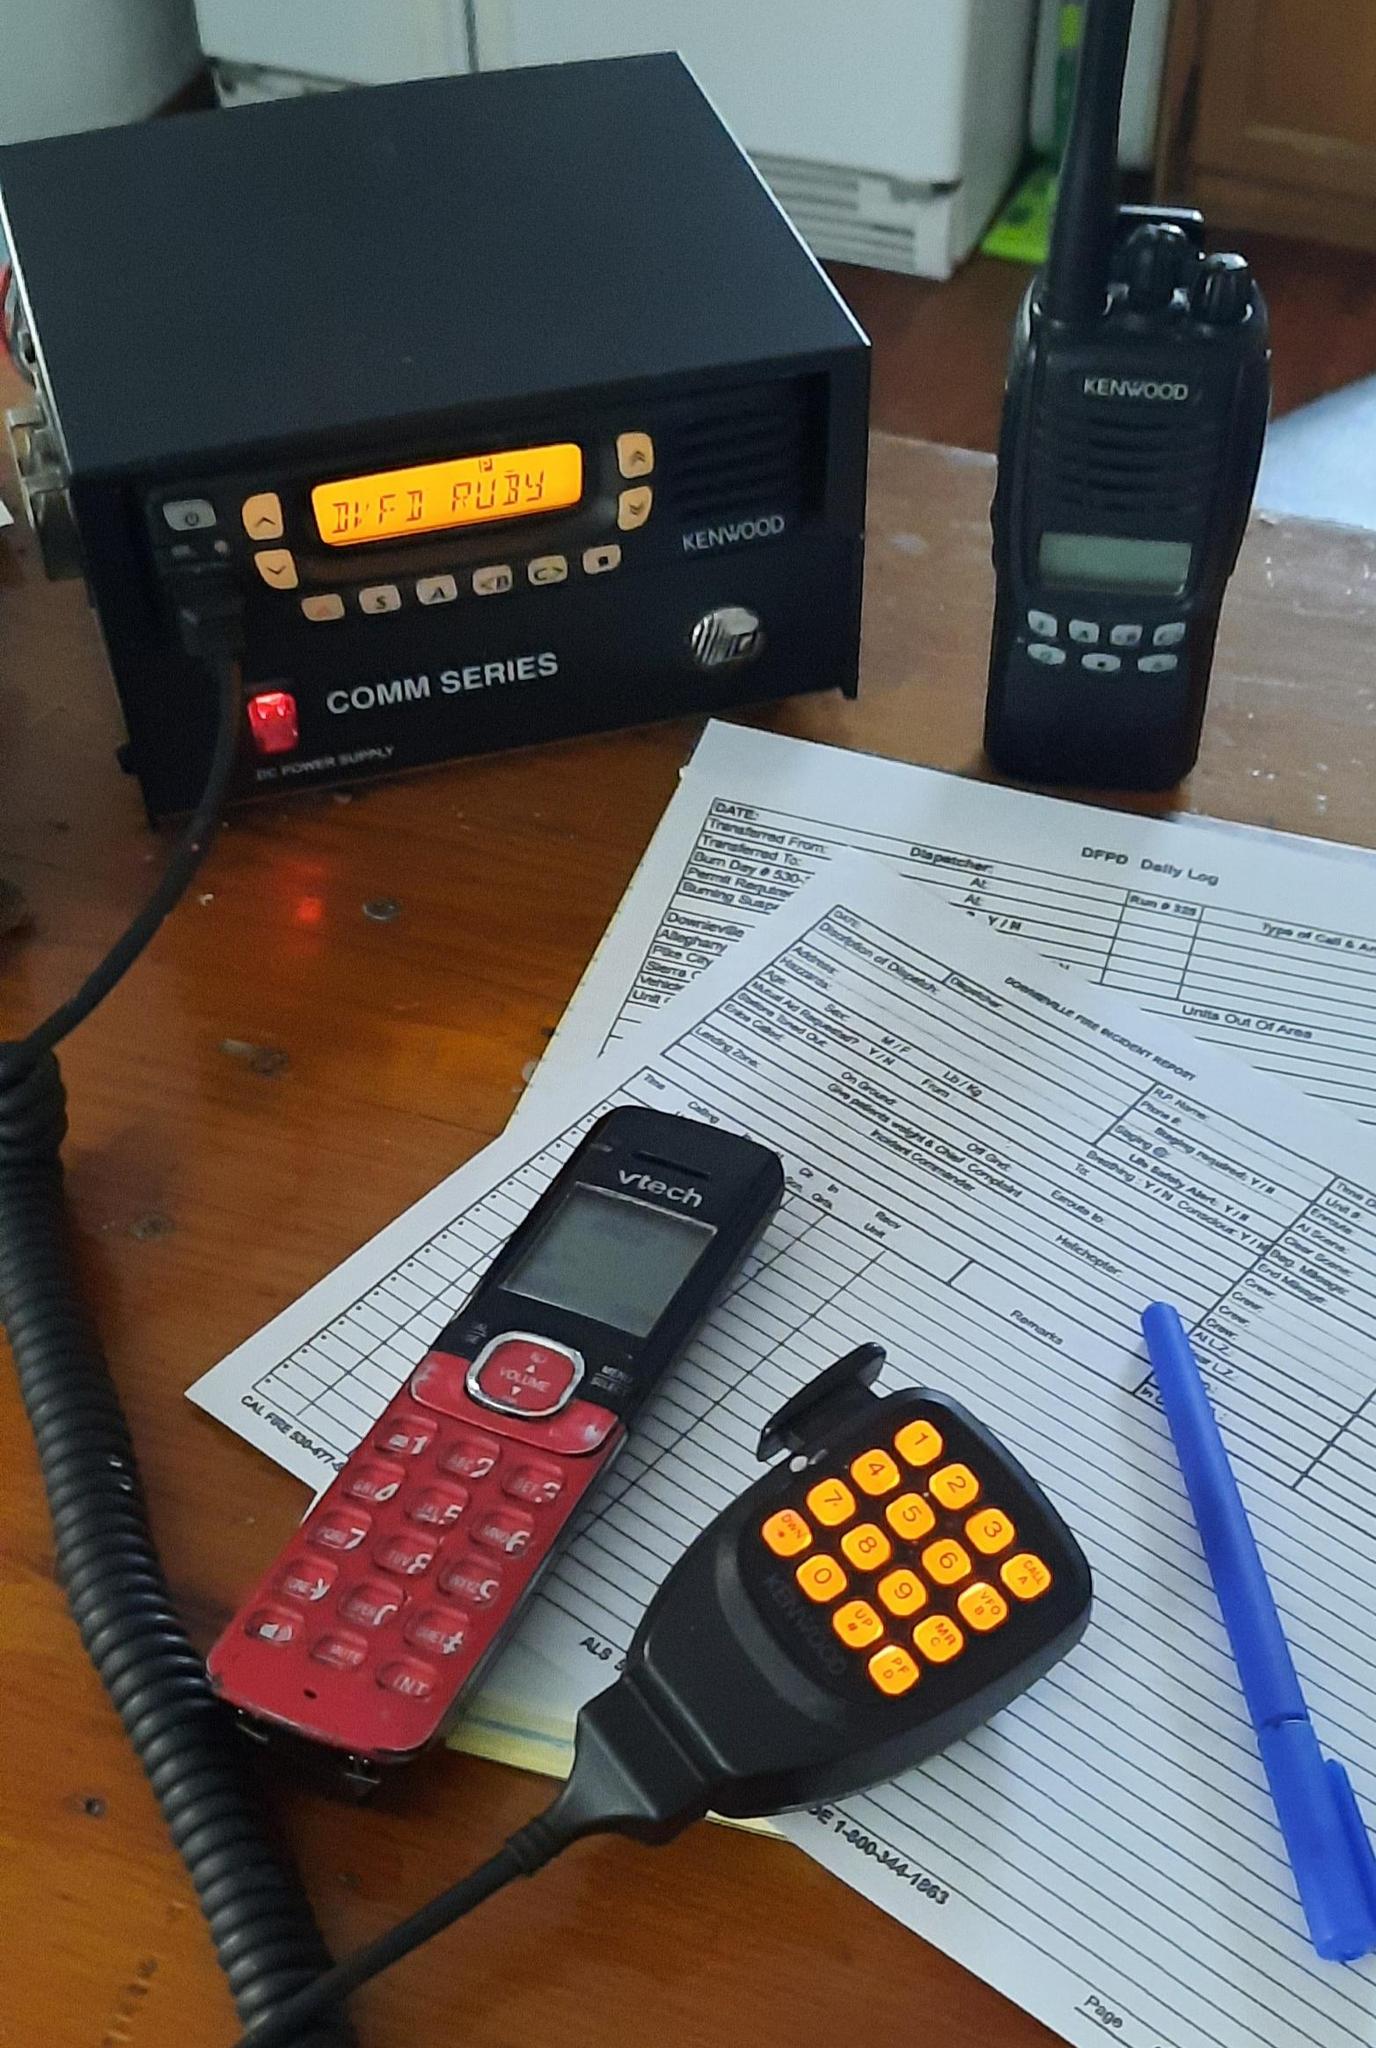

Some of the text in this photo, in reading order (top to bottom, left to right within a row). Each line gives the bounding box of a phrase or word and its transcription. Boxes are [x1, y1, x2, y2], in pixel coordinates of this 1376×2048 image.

[1083, 377, 1189, 401] KENWOOD
[682, 515, 785, 552] KENWOOD
[326, 652, 559, 714] COMM SERIES
[281, 756, 337, 775] POWER
[339, 746, 395, 766] SUPPLY
[709, 817, 785, 845] Transferred
[702, 835, 778, 861] Transferred
[687, 866, 731, 884] Permit
[729, 859, 757, 876] Day
[1081, 846, 1219, 887] DFPD Daily Log
[1262, 921, 1293, 938] Type
[1297, 929, 1312, 940] of
[1182, 1004, 1313, 1039] Units Out Of Area
[1100, 1027, 1152, 1058] INCIDENT
[1152, 1055, 1196, 1081] REPORT
[617, 1168, 703, 1209] vtech
[1009, 1309, 1064, 1346] Remarks
[500, 1366, 550, 1393] VOLUME
[241, 1395, 266, 1417] CAL
[264, 1412, 293, 1435] FIRE
[410, 1435, 428, 1455] 1
[915, 1432, 929, 1447] 1
[867, 1461, 886, 1478] 4
[946, 1475, 967, 1493] 2
[823, 1488, 843, 1506] 7
[901, 1504, 922, 1523] 5
[344, 1527, 367, 1550] 7
[780, 1512, 806, 1541] DWN
[983, 1521, 1003, 1539] 3
[857, 1535, 878, 1555] 8
[938, 1551, 959, 1570] 6
[1022, 1559, 1045, 1586] CALL
[813, 1567, 833, 1585] 0
[893, 1581, 914, 1600] 9
[979, 1590, 1001, 1617] VFO
[854, 1608, 875, 1628] UP
[934, 1621, 958, 1646] MR
[579, 1636, 613, 1661] ALS
[891, 1656, 910, 1675] PF
[393, 1674, 430, 1697] INT
[1083, 1994, 1124, 2030] Page
